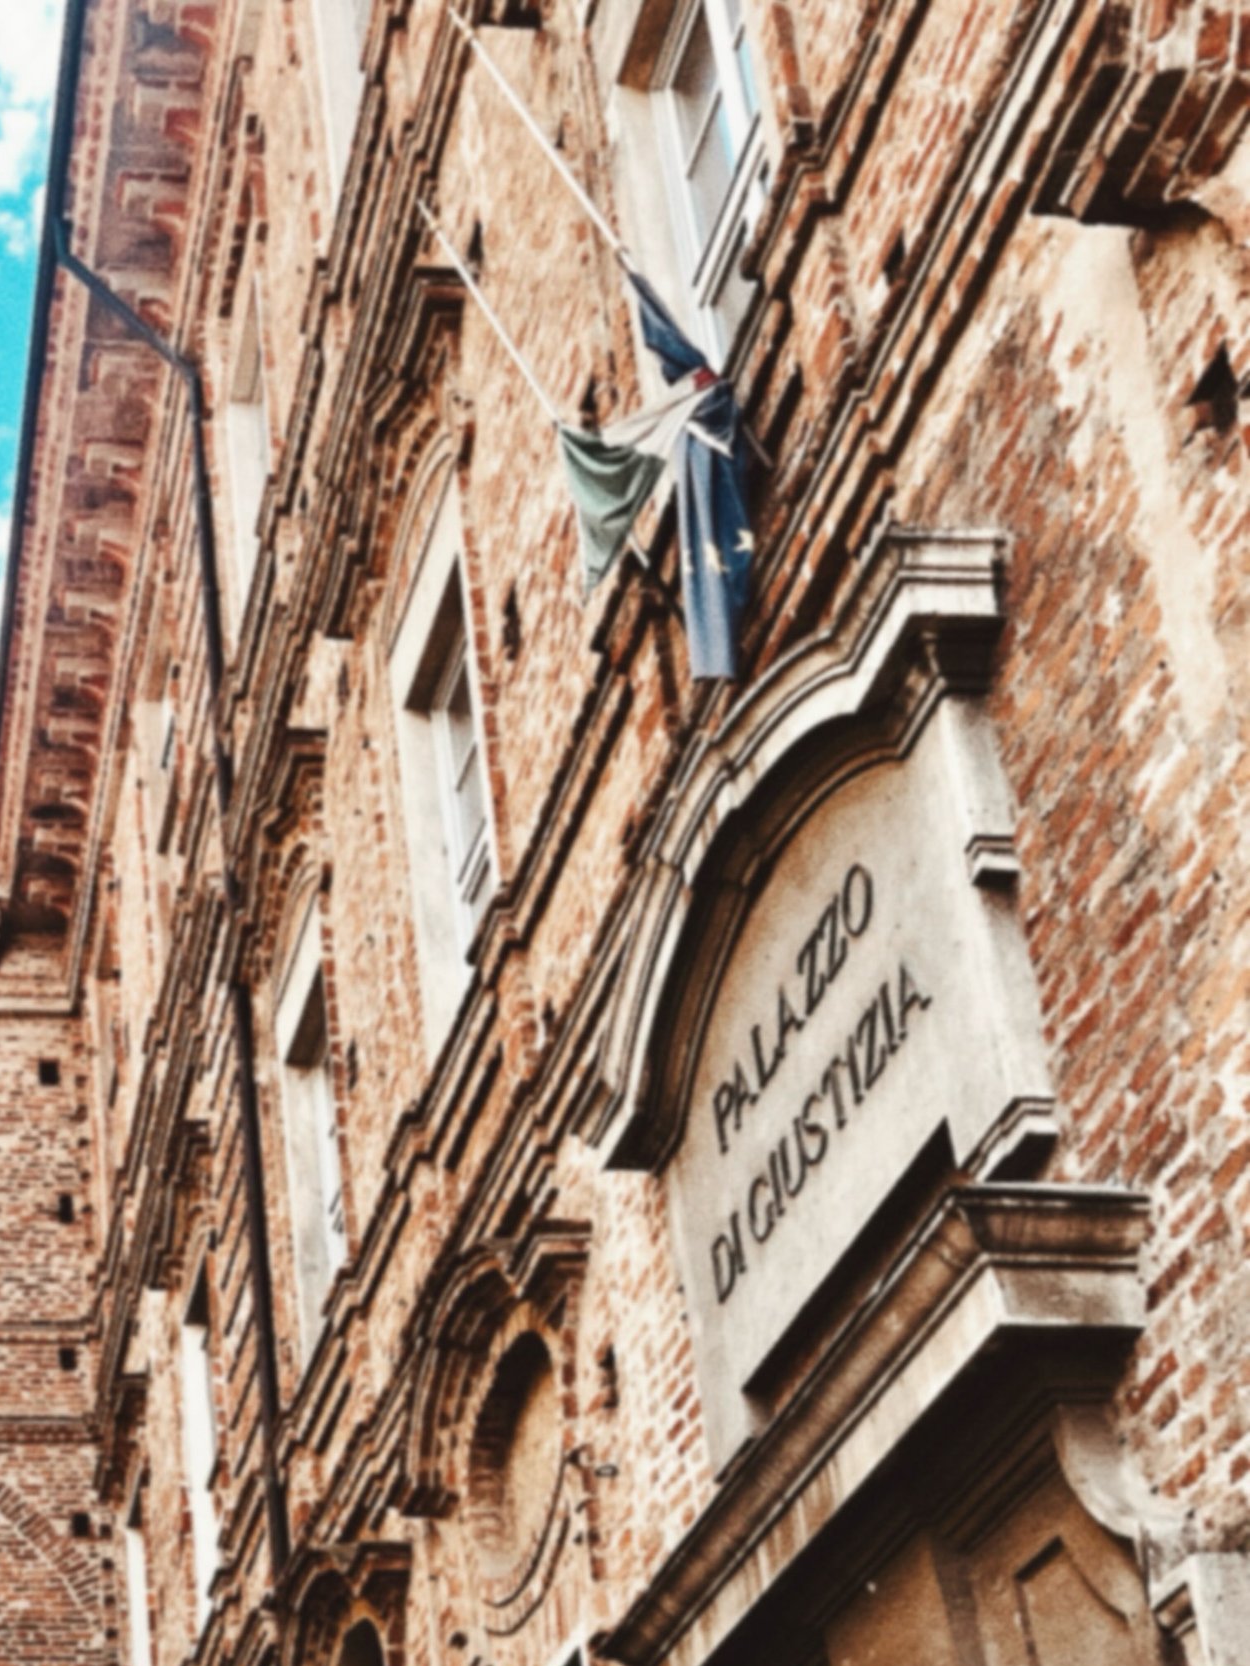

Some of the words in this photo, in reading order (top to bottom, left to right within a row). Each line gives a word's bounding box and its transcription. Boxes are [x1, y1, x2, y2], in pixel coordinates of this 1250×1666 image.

[711, 1211, 747, 1304] DI
[748, 964, 932, 1243] GIUSTIZIA
[712, 864, 873, 1155] PALAZZO
